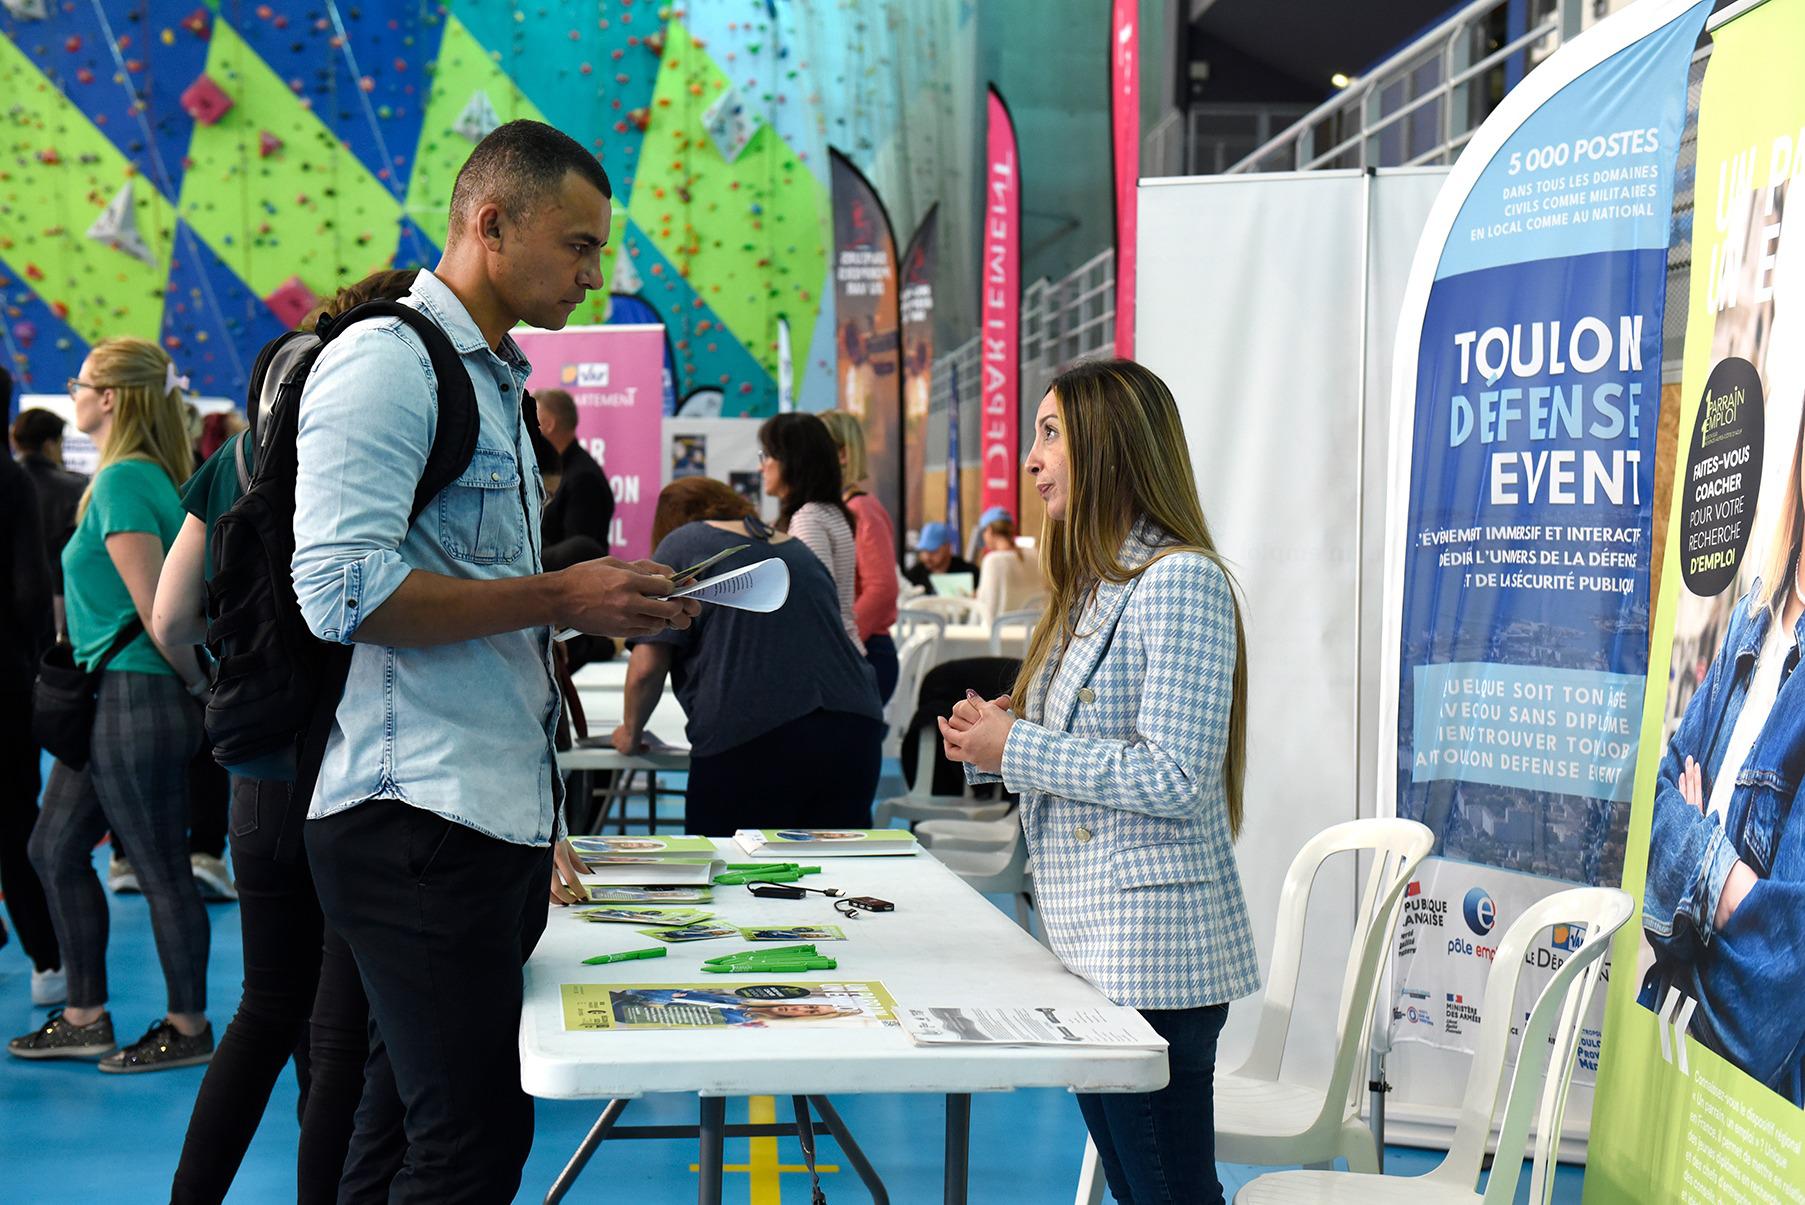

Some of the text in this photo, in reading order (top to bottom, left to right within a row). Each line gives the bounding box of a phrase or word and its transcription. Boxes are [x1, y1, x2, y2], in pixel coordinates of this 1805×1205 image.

[1508, 127, 1659, 176] 5 000 POSTES
[1503, 165, 1659, 200] DANS TOUS LES DOMAINES
[1504, 184, 1657, 217] CIVILS COMME MILITAIRES
[1471, 203, 1654, 241] EN LOCAL COMME AU NATIONAL
[1454, 315, 1643, 384] TOULON
[1450, 372, 1642, 448] DÉFENSE
[1490, 450, 1641, 505] EVENT
[1693, 444, 1751, 482] FAITES-VOUS
[1695, 473, 1742, 502] COACHER
[1689, 495, 1745, 528] POUR VOTRE
[1486, 525, 1542, 540] IMMERSIF
[1545, 526, 1563, 541] ET
[1688, 521, 1742, 552] RECHERCHE
[1540, 551, 1559, 565] DE
[1564, 551, 1585, 566] LA
[1690, 548, 1736, 575] D'EMPLOI
[1475, 573, 1497, 587] DE
[1500, 573, 1510, 588] LA
[1511, 570, 1575, 590] SÉCURITÉ
[1513, 682, 1554, 701] SOIT
[1563, 686, 1604, 705] TON
[1607, 685, 1627, 709] ÂGE
[1480, 703, 1501, 721] OU
[1509, 705, 1557, 727] SANS
[1566, 711, 1630, 735] DIPLÔME
[1478, 726, 1557, 752] TROUVER
[1600, 740, 1630, 759] JOB
[1501, 753, 1580, 779] DEFENSE
[1448, 937, 1498, 964] pôle emp
[1446, 1003, 1478, 1015] MINISTÈRE
[1446, 1010, 1459, 1018] DES
[1459, 1012, 1481, 1024] ARMÉES
